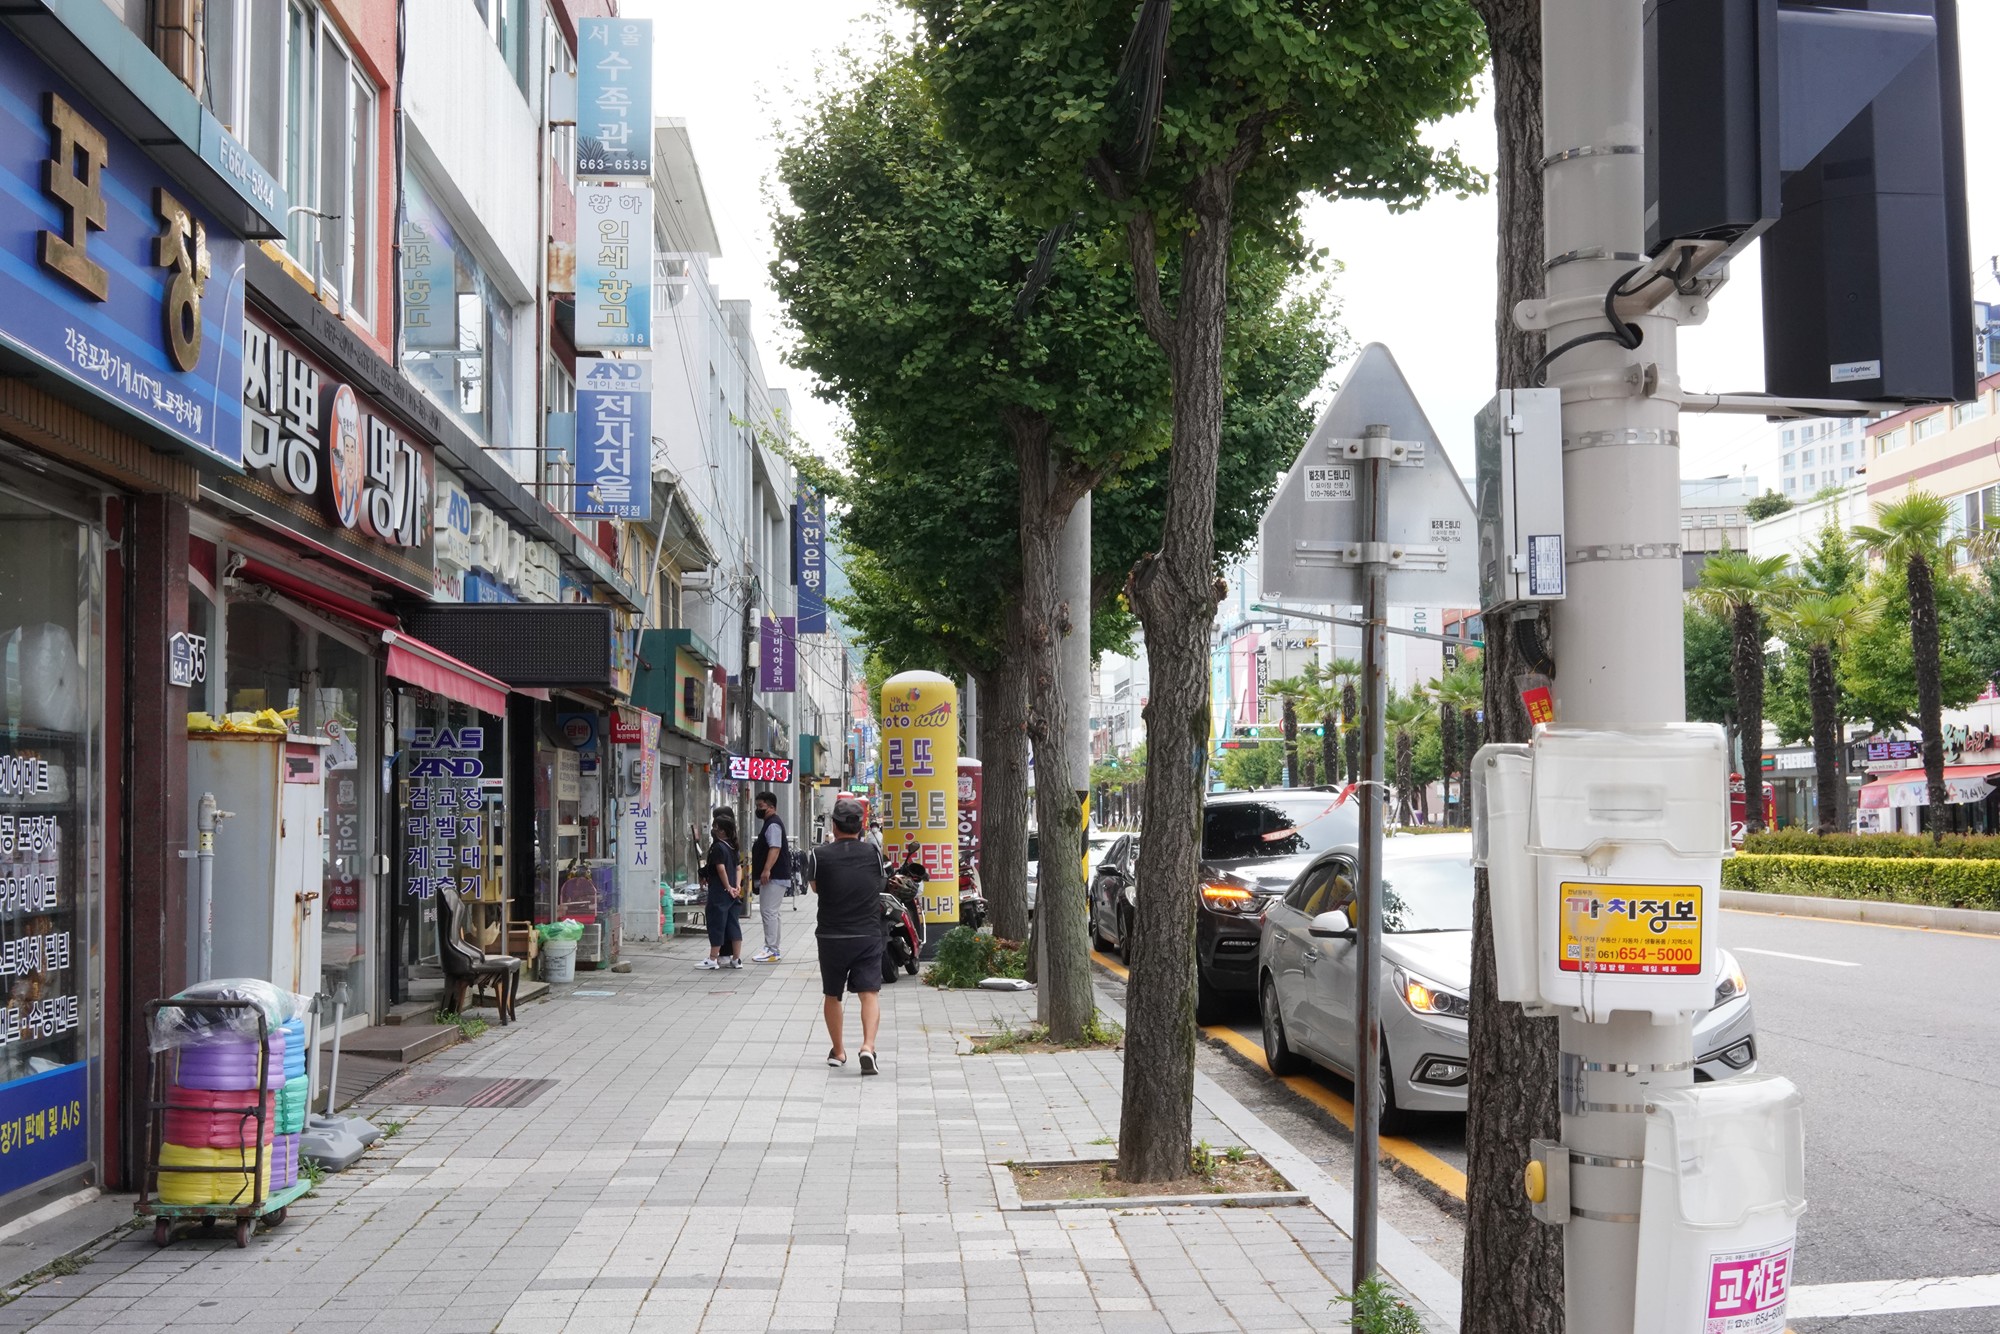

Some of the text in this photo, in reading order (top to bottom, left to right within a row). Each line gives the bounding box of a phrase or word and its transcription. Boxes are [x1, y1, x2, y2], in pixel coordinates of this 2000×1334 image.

[595, 51, 633, 152] 수족관
[220, 135, 274, 212] F.664-5844
[579, 159, 647, 170] 663-6535
[586, 362, 642, 381] AND
[244, 316, 321, 496] 짬뽕
[368, 414, 423, 549] 명가
[594, 395, 635, 502] 전자저울
[1328, 470, 1350, 480] 드립니다
[174, 661, 189, 682] 64-1
[890, 702, 916, 713] Lotto
[409, 758, 484, 779] AND
[887, 737, 935, 778] 로또
[629, 802, 651, 818] 국제
[18, 816, 57, 853] 포장지
[408, 816, 483, 839] 라벨지
[408, 846, 482, 869] 계근대
[633, 821, 648, 866] 문구사
[19, 874, 57, 912] 테이프
[920, 896, 954, 915] 나라
[1566, 898, 1697, 933] 까치정보
[25, 1109, 45, 1146] 판매
[49, 1105, 58, 1137] 및
[61, 1100, 80, 1131] A/S
